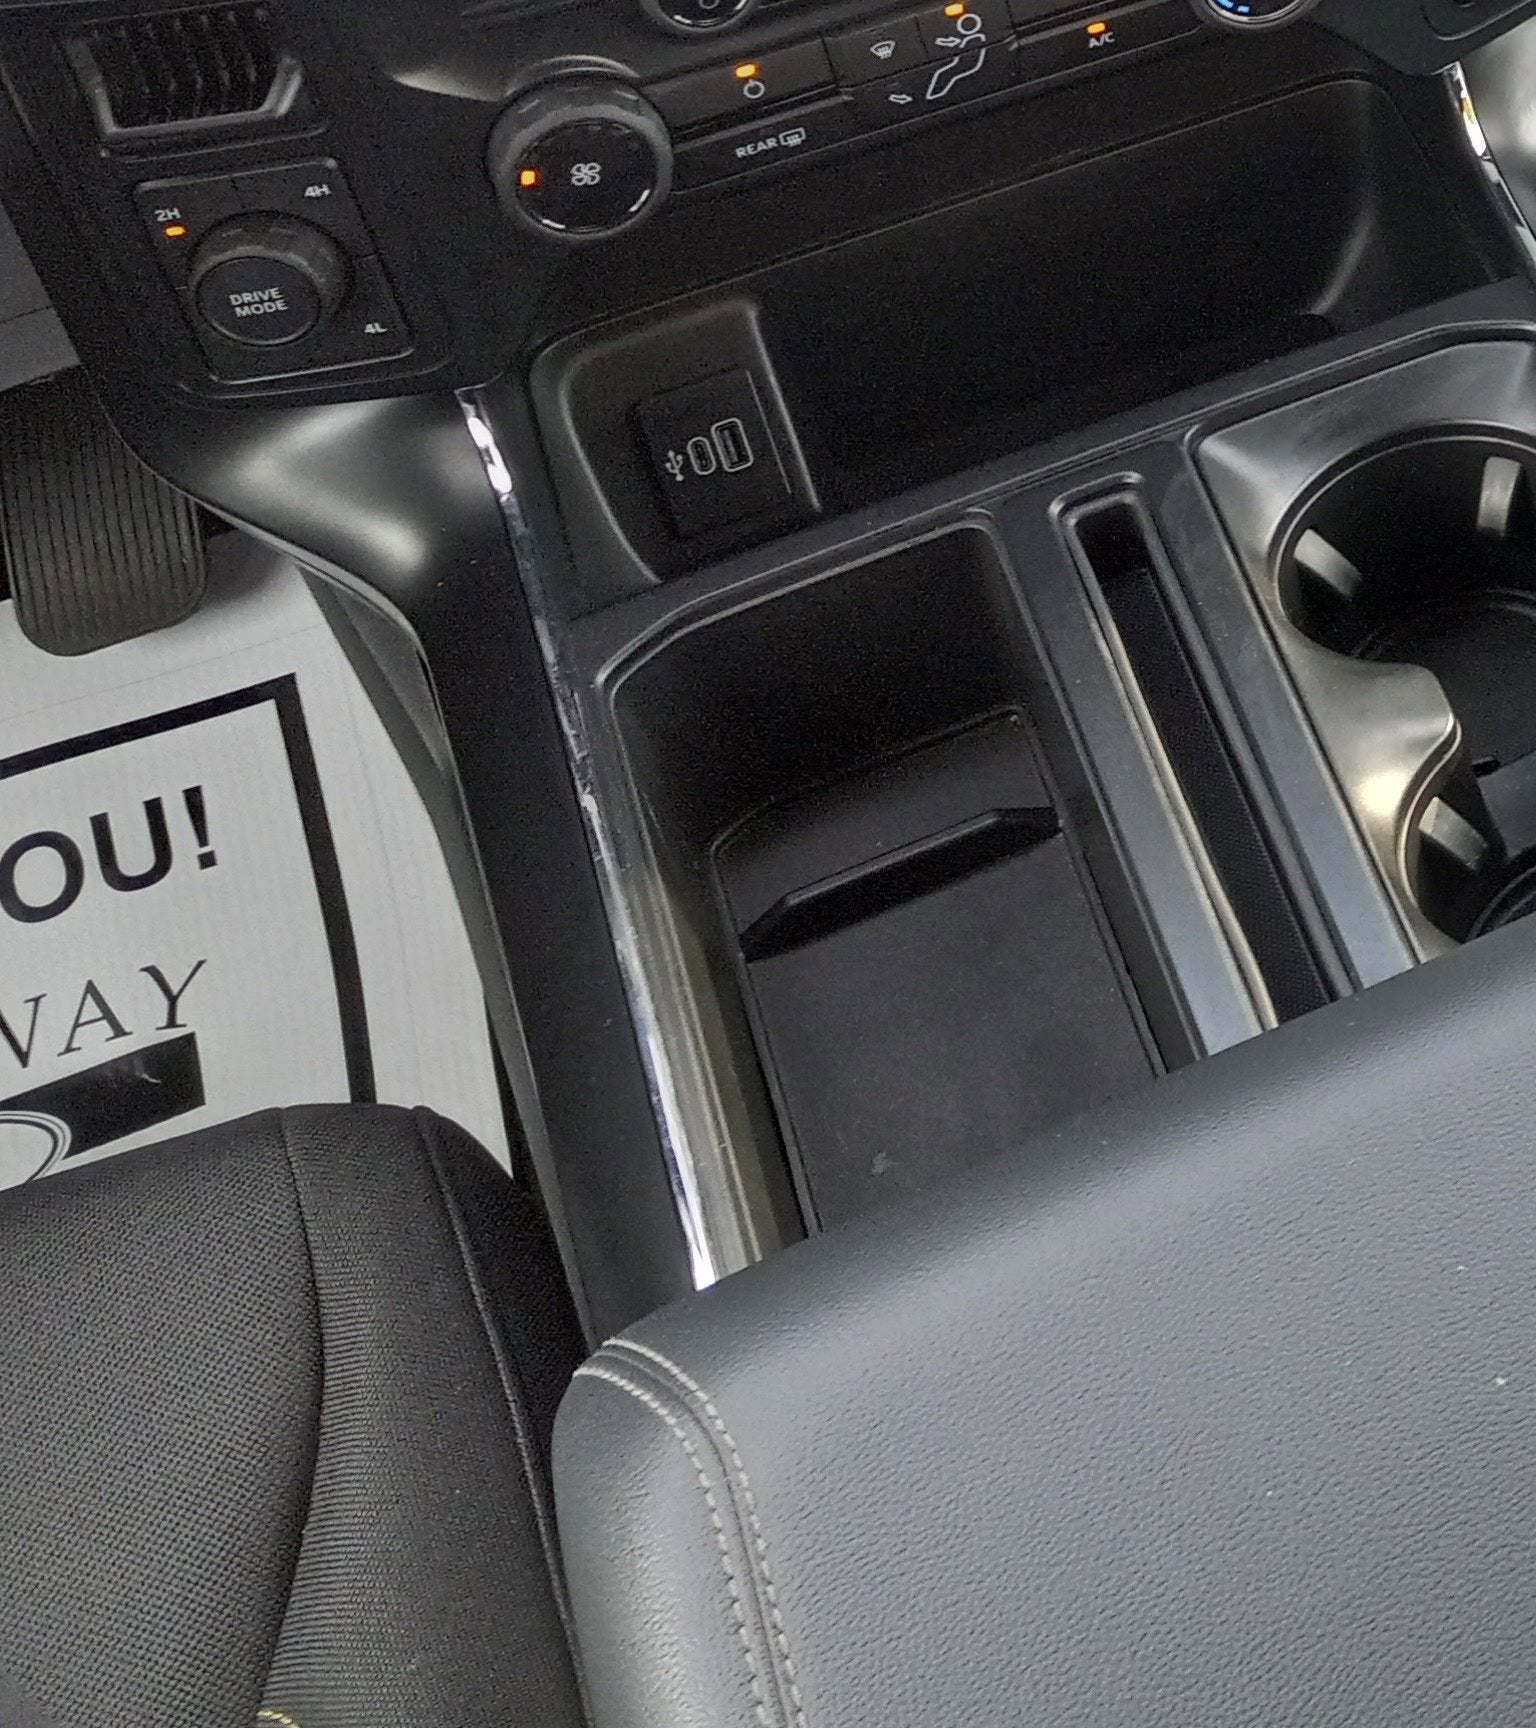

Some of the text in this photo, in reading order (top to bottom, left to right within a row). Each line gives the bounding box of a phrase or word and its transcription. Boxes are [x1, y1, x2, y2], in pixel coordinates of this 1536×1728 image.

[1088, 31, 1116, 49] A/C
[735, 136, 779, 159] REAR
[303, 182, 332, 198] 4H
[154, 206, 182, 223] 2H
[228, 286, 285, 307] DRIVE
[234, 298, 290, 318] MODE
[363, 321, 389, 334] 4L
